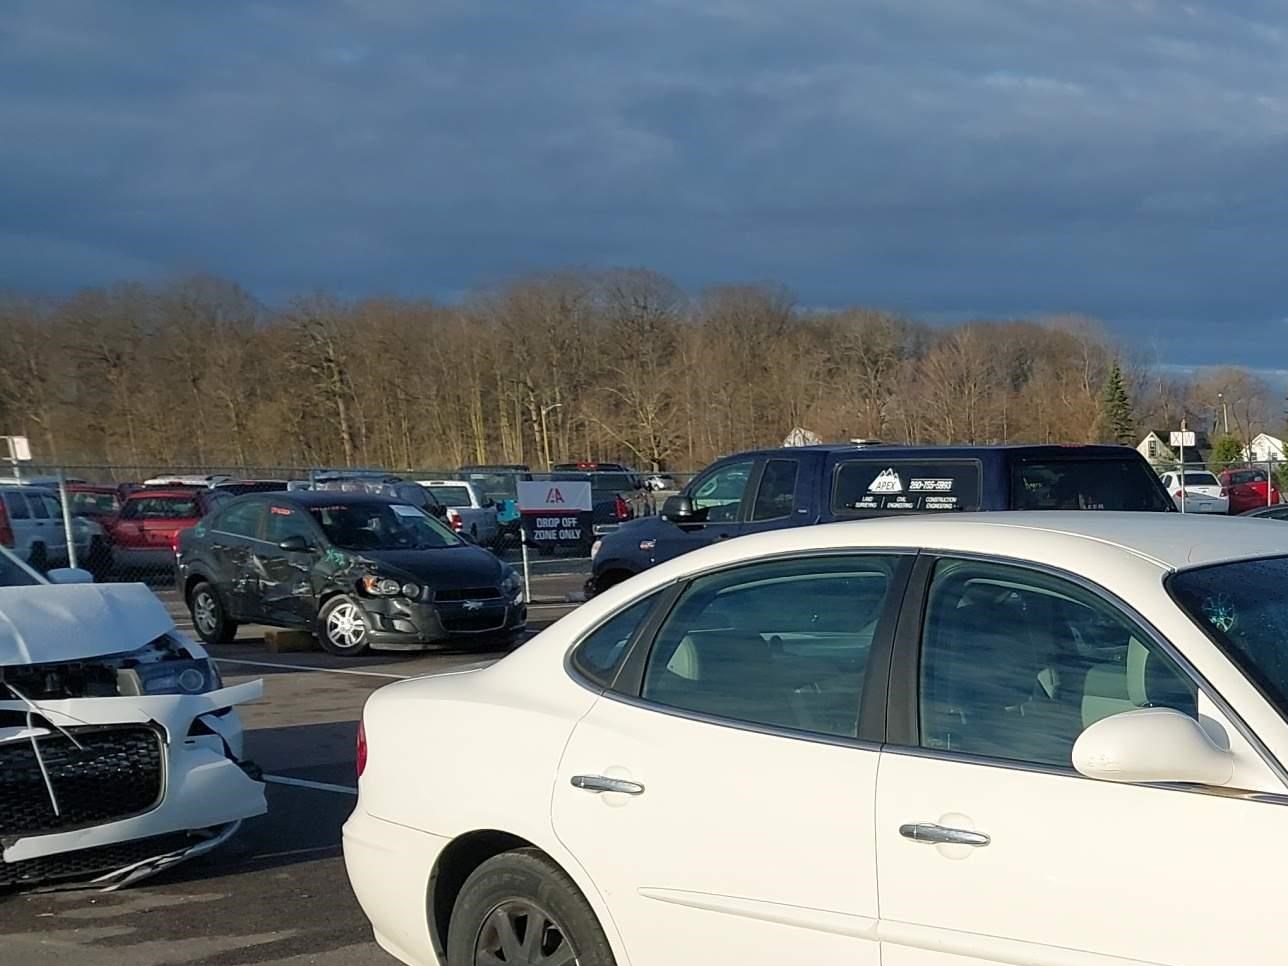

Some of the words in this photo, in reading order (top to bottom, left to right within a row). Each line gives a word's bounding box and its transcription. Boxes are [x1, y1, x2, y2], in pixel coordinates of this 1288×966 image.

[876, 481, 896, 490] APEX
[536, 517, 560, 528] DROP
[562, 517, 578, 528] OFF
[533, 529, 558, 540] ZONE
[559, 529, 581, 540] ONLY
